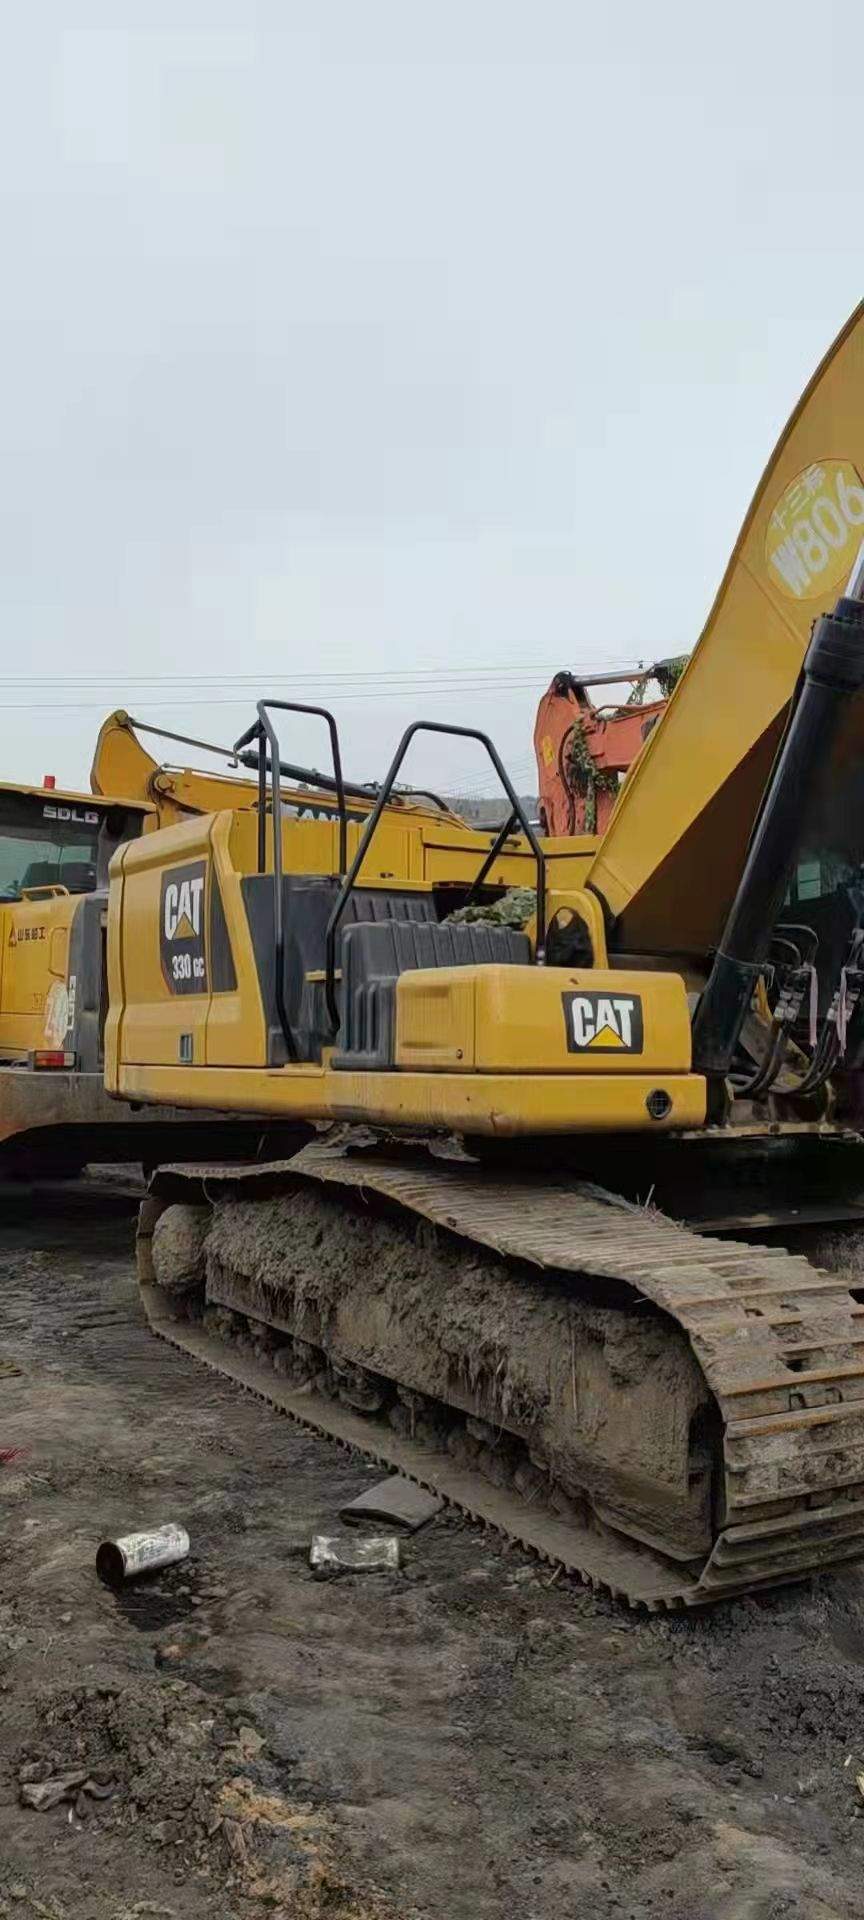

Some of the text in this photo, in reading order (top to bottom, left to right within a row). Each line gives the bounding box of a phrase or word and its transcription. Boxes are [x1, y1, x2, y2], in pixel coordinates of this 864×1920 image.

[771, 471, 864, 596] W806
[43, 805, 99, 824] SDLG
[164, 878, 204, 941] CAT
[172, 953, 205, 980] 330 GC
[572, 997, 634, 1048] CAT
